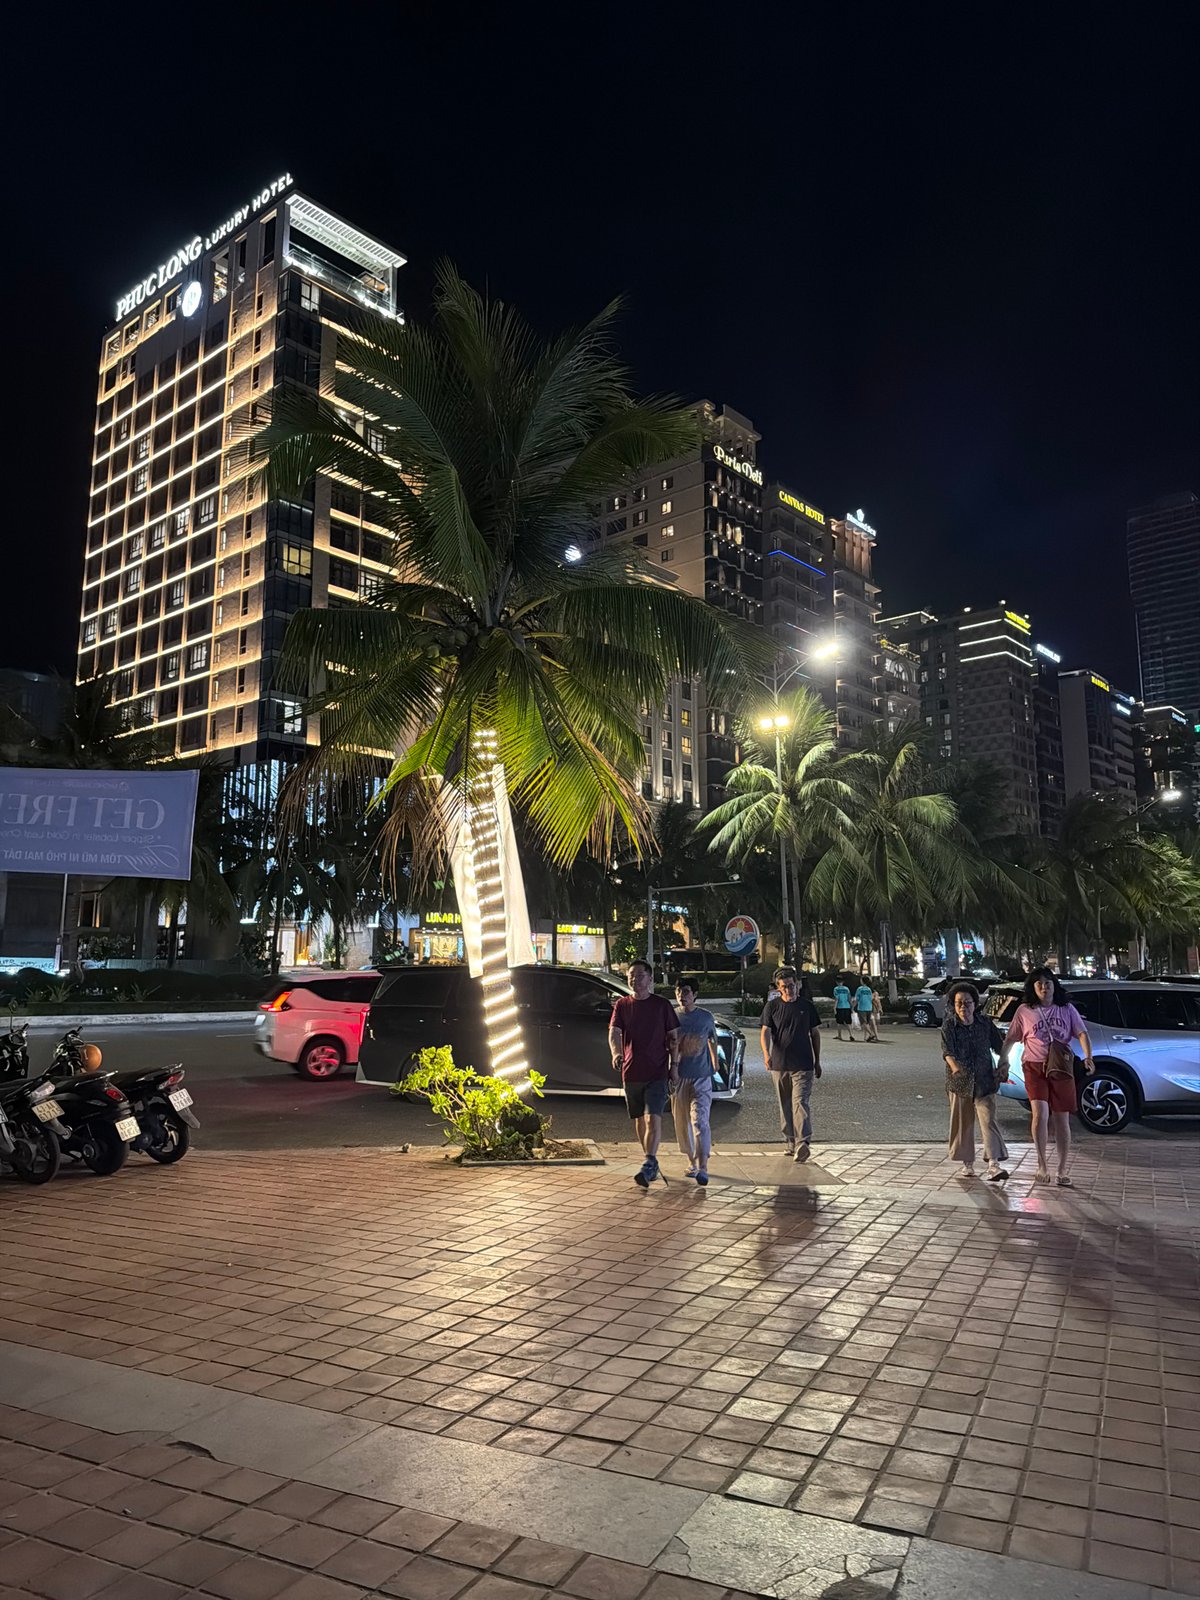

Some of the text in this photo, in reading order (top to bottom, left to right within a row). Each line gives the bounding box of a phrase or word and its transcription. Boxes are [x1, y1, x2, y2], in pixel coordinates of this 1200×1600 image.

[115, 172, 294, 322] PHUC LONG LUXURY HOTEL
[713, 445, 764, 486] Paris Deli
[778, 490, 826, 525] CANVAS HOTEL
[425, 912, 454, 924] LUNAR
[556, 924, 604, 935] EAFRONT HOTE
